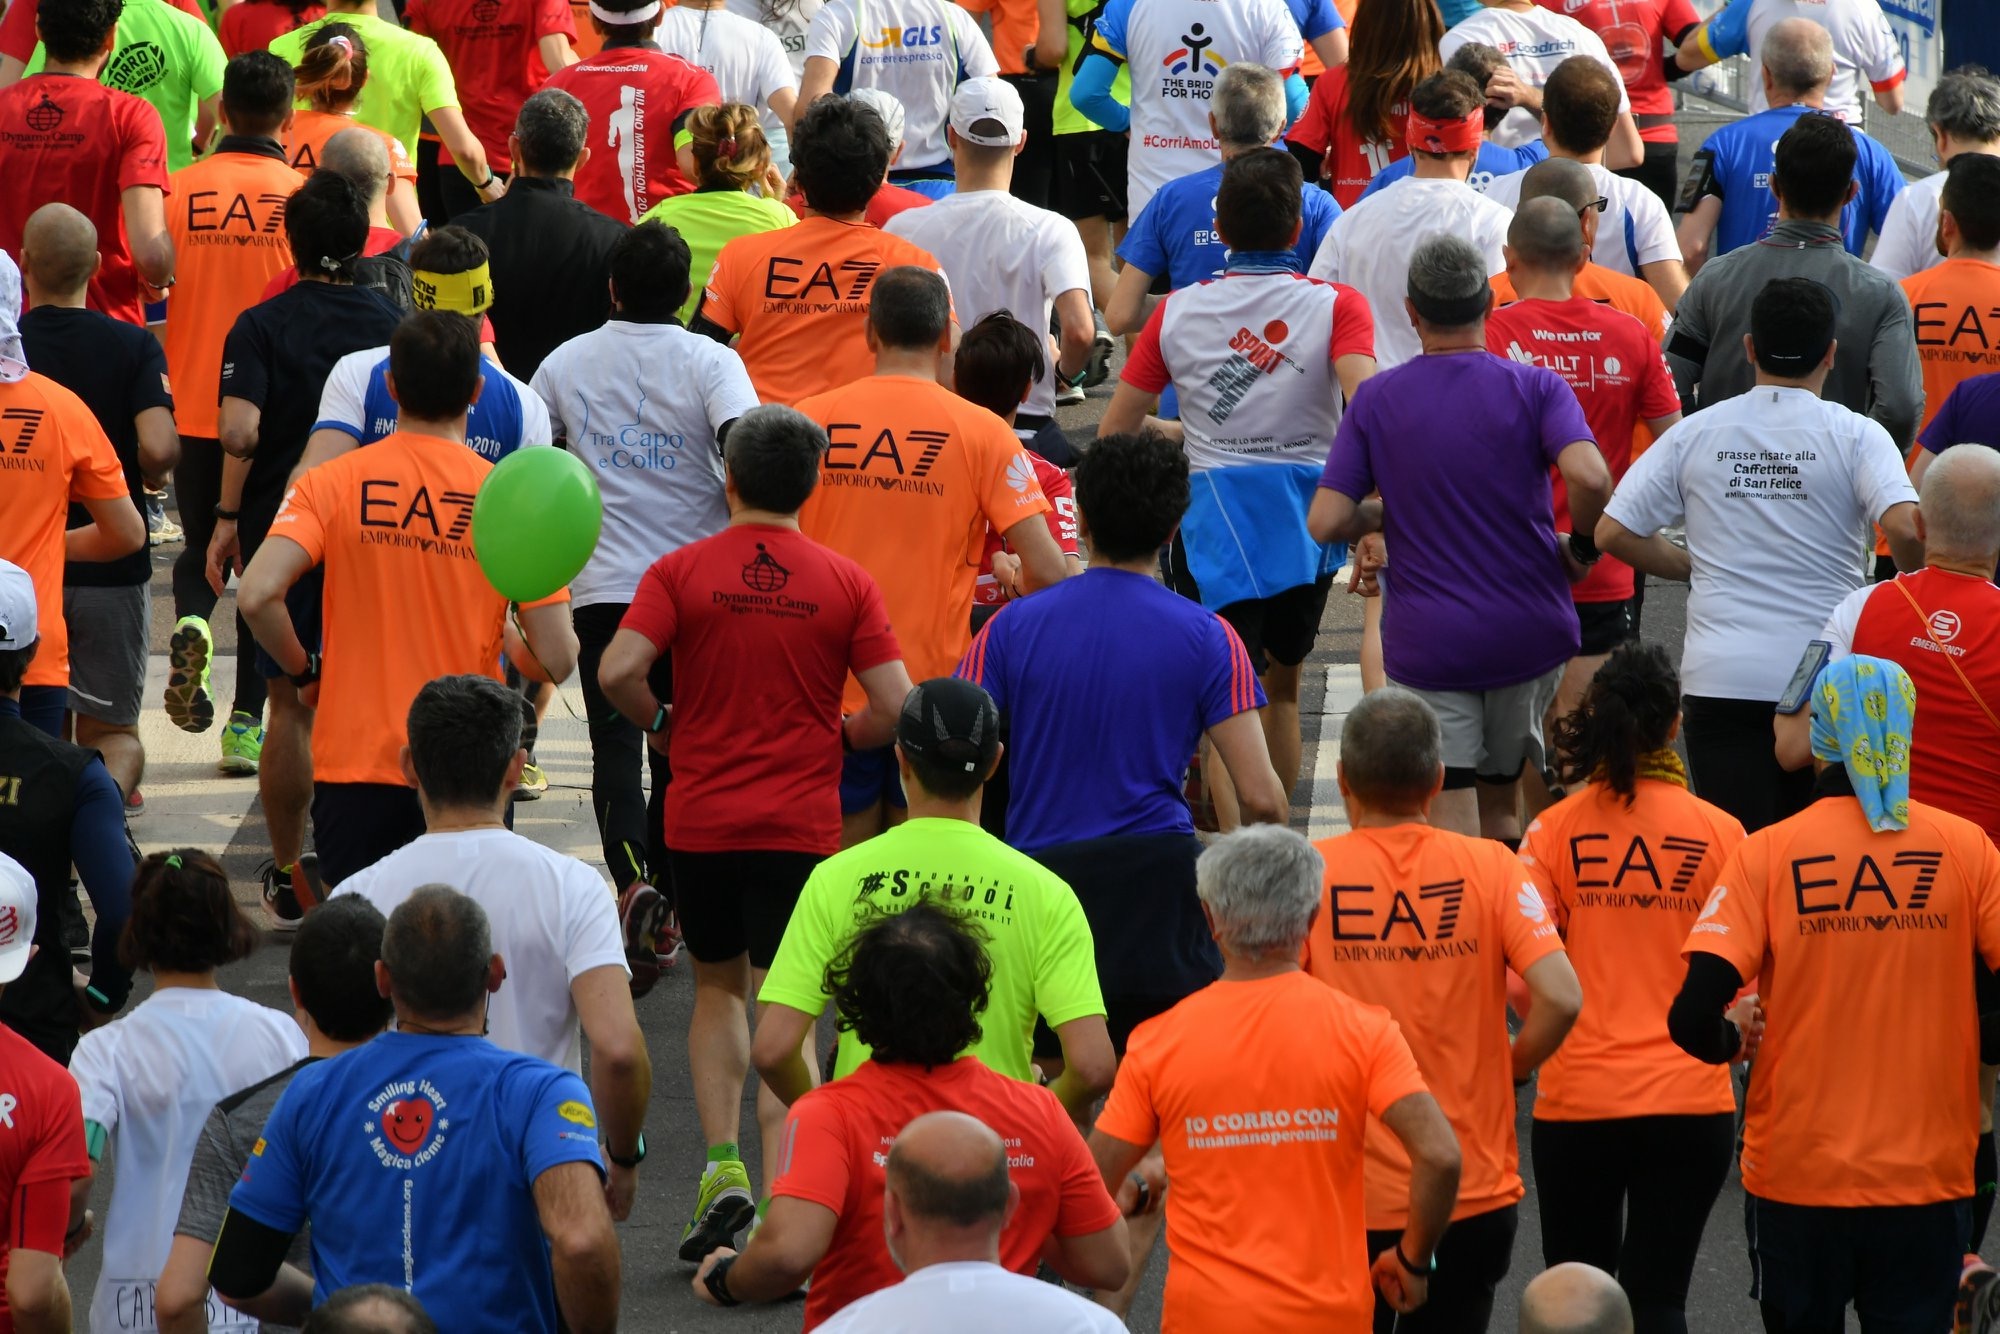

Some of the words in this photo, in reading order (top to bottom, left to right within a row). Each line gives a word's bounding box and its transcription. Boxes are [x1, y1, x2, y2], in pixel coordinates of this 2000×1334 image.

[903, 26, 941, 47] GLS
[1499, 39, 1575, 53] BFGoodrich
[861, 54, 898, 65] corriere
[899, 53, 943, 64] espresso
[1162, 78, 1183, 88] THE
[1187, 79, 1214, 89] BRID
[1162, 87, 1187, 99] FOR
[1191, 88, 1214, 100] HO
[634, 88, 646, 130] MILANO
[52, 131, 85, 143] Camp
[1143, 135, 1222, 150] #CorriAmoL
[634, 132, 647, 194] MARATHON
[188, 191, 288, 233] EA7
[637, 196, 648, 217] 201
[188, 234, 237, 247] EMPORIO
[249, 234, 289, 248] ARMAN
[765, 256, 881, 301] EA7
[763, 302, 817, 315] EMPORIO
[832, 302, 871, 314] ARMAN
[1532, 329, 1556, 341] We
[1557, 331, 1581, 342] run
[1581, 330, 1602, 341] for
[1228, 326, 1286, 376] SPORT
[1543, 354, 1581, 372] LILT
[375, 418, 398, 435] #Mi
[464, 436, 501, 458] n2018
[589, 432, 615, 446] Tra
[620, 428, 684, 449] Capo
[1250, 436, 1274, 445] SPORT
[598, 457, 608, 469] e
[611, 448, 676, 470] Collo
[824, 423, 951, 477] EA7
[1717, 450, 1757, 462] grasse
[1760, 449, 1792, 461] risate
[1795, 450, 1817, 461] alla
[1733, 463, 1799, 475] Caffetteria
[822, 472, 878, 489] EMPORIO
[896, 478, 944, 497] ARMANI
[1729, 476, 1742, 488] di
[1743, 478, 1767, 489] San
[1769, 478, 1802, 489] Felice
[1725, 491, 1808, 501] #MilanoMarathon2018
[360, 480, 476, 541] EA7
[360, 530, 420, 547] EMPORIO
[433, 541, 478, 561] ARMAN
[712, 590, 773, 608] Dynamo
[776, 594, 819, 617] Camp
[1570, 834, 1710, 893] EA7
[890, 869, 1014, 911] SCHOOL
[914, 871, 1015, 892] RUNNING
[1791, 851, 1943, 915] EA7
[1331, 878, 1466, 942] EA7
[1570, 893, 1634, 909] EMPORIO
[1799, 915, 1869, 935] EMPORIO
[1889, 913, 1948, 931] ARMANI
[1333, 944, 1404, 962] EMPORIO
[1422, 938, 1479, 961] ARMANI
[367, 1081, 416, 1113] Smiling
[418, 1079, 448, 1111] Heart
[1185, 1116, 1208, 1134] IO
[1212, 1109, 1291, 1133] CORRO
[1293, 1107, 1340, 1127] CON
[1001, 1137, 1022, 1148] 018
[1187, 1127, 1338, 1150] #unamanoperonlus
[369, 1136, 412, 1171] Magica
[401, 1179, 414, 1296] .magicacleme.org
